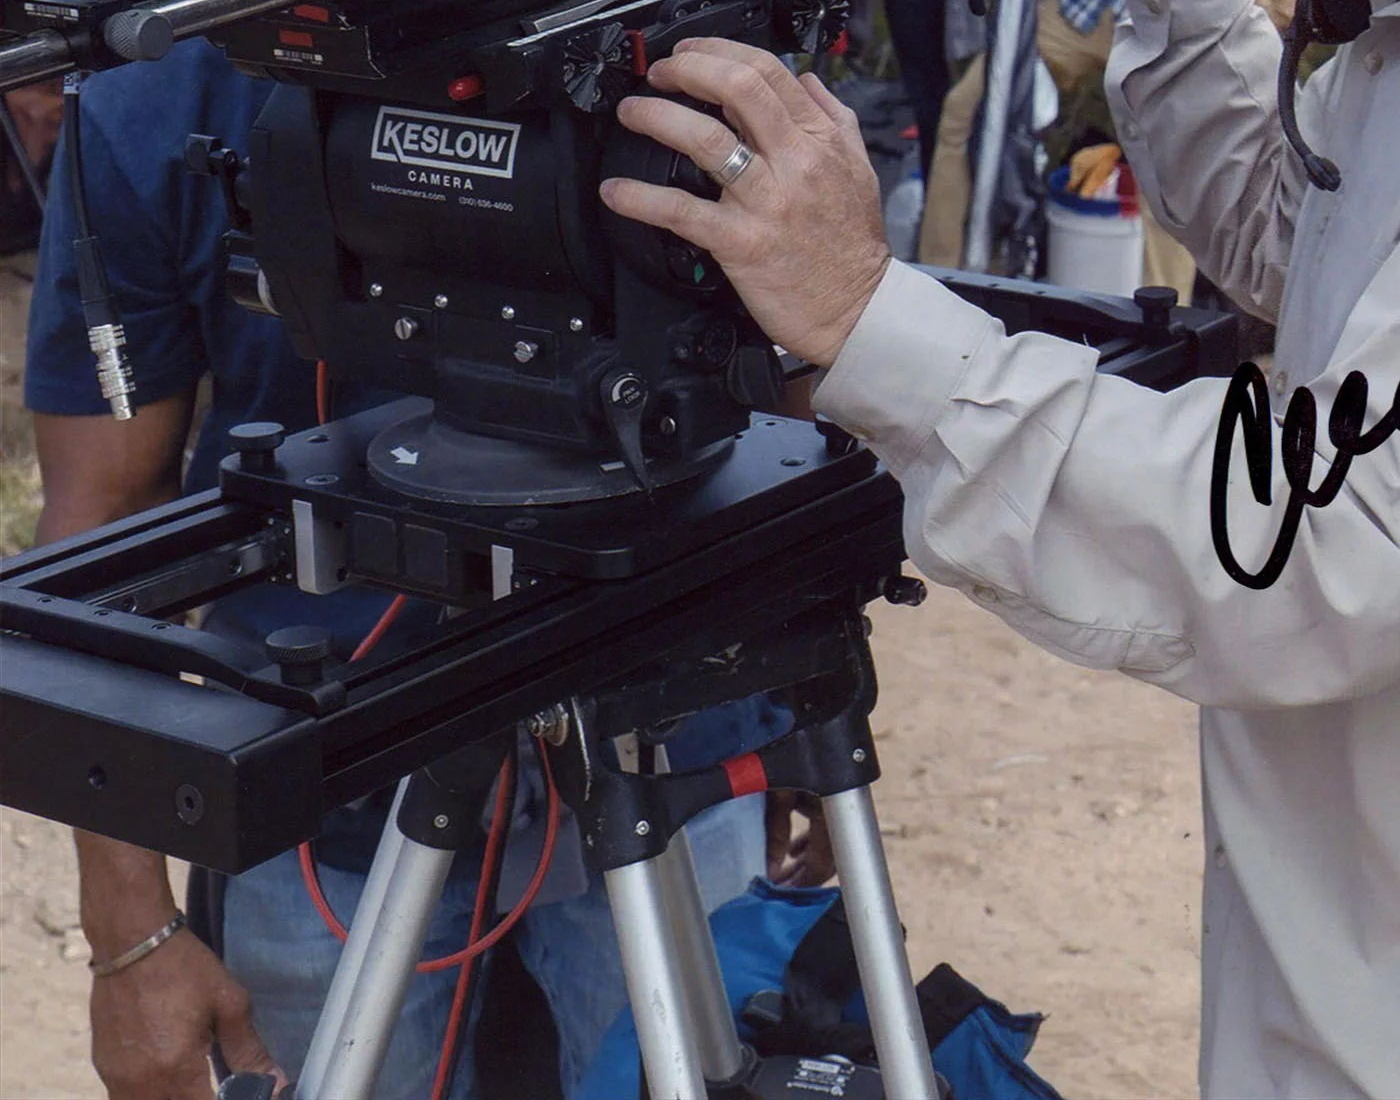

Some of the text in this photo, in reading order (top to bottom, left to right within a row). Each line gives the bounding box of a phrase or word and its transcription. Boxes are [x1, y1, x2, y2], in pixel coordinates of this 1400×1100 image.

[382, 120, 507, 163] KESLOW
[408, 170, 473, 190] CAMERA
[371, 182, 447, 201] keslowcamera.com
